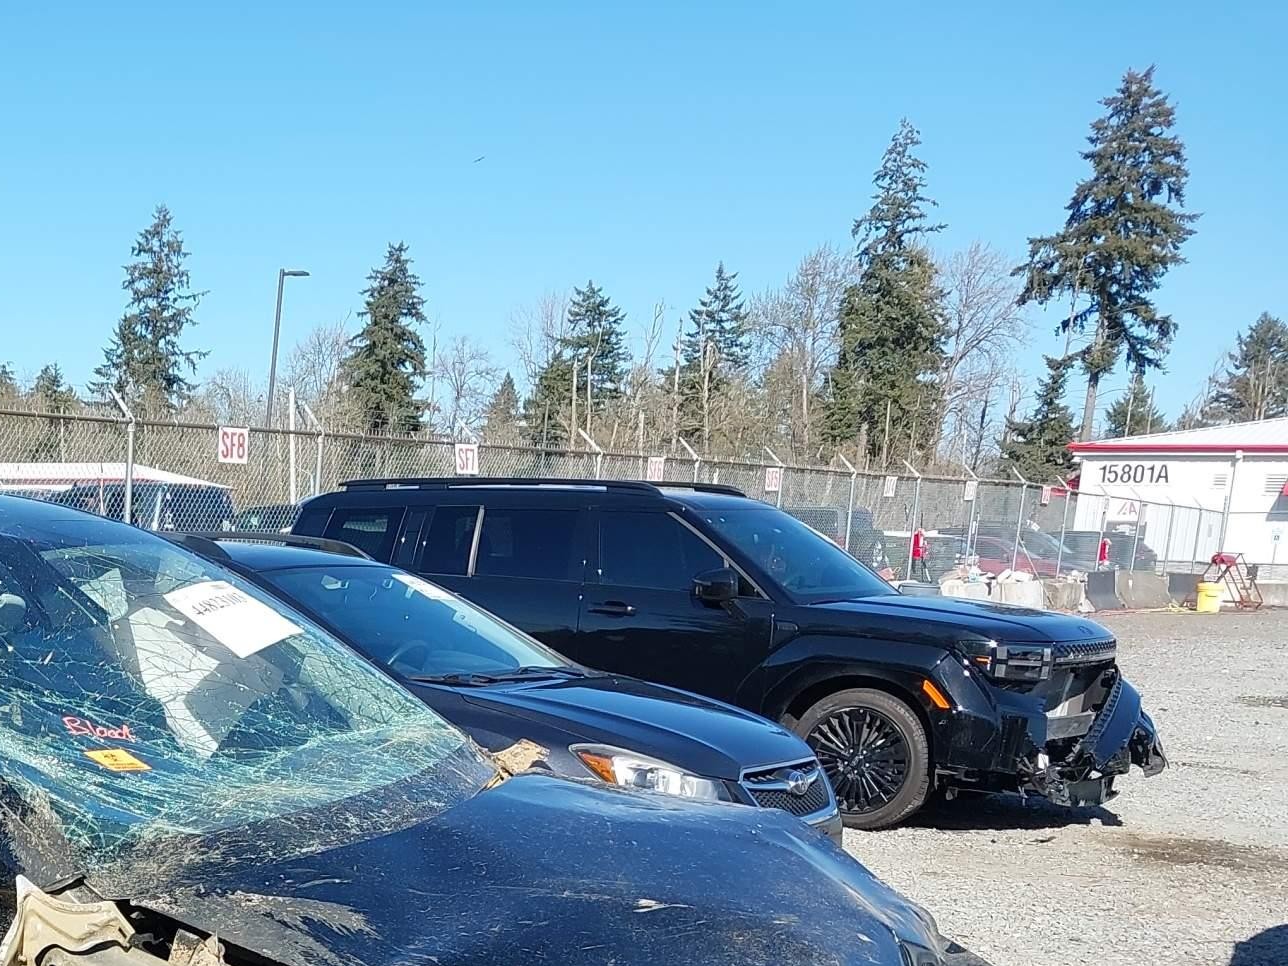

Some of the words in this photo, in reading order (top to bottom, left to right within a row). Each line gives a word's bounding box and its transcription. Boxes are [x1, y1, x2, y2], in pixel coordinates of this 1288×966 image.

[221, 431, 245, 459] SF8
[458, 447, 475, 470] SF7
[1099, 463, 1169, 483] 15801A
[62, 715, 136, 743] Blood
